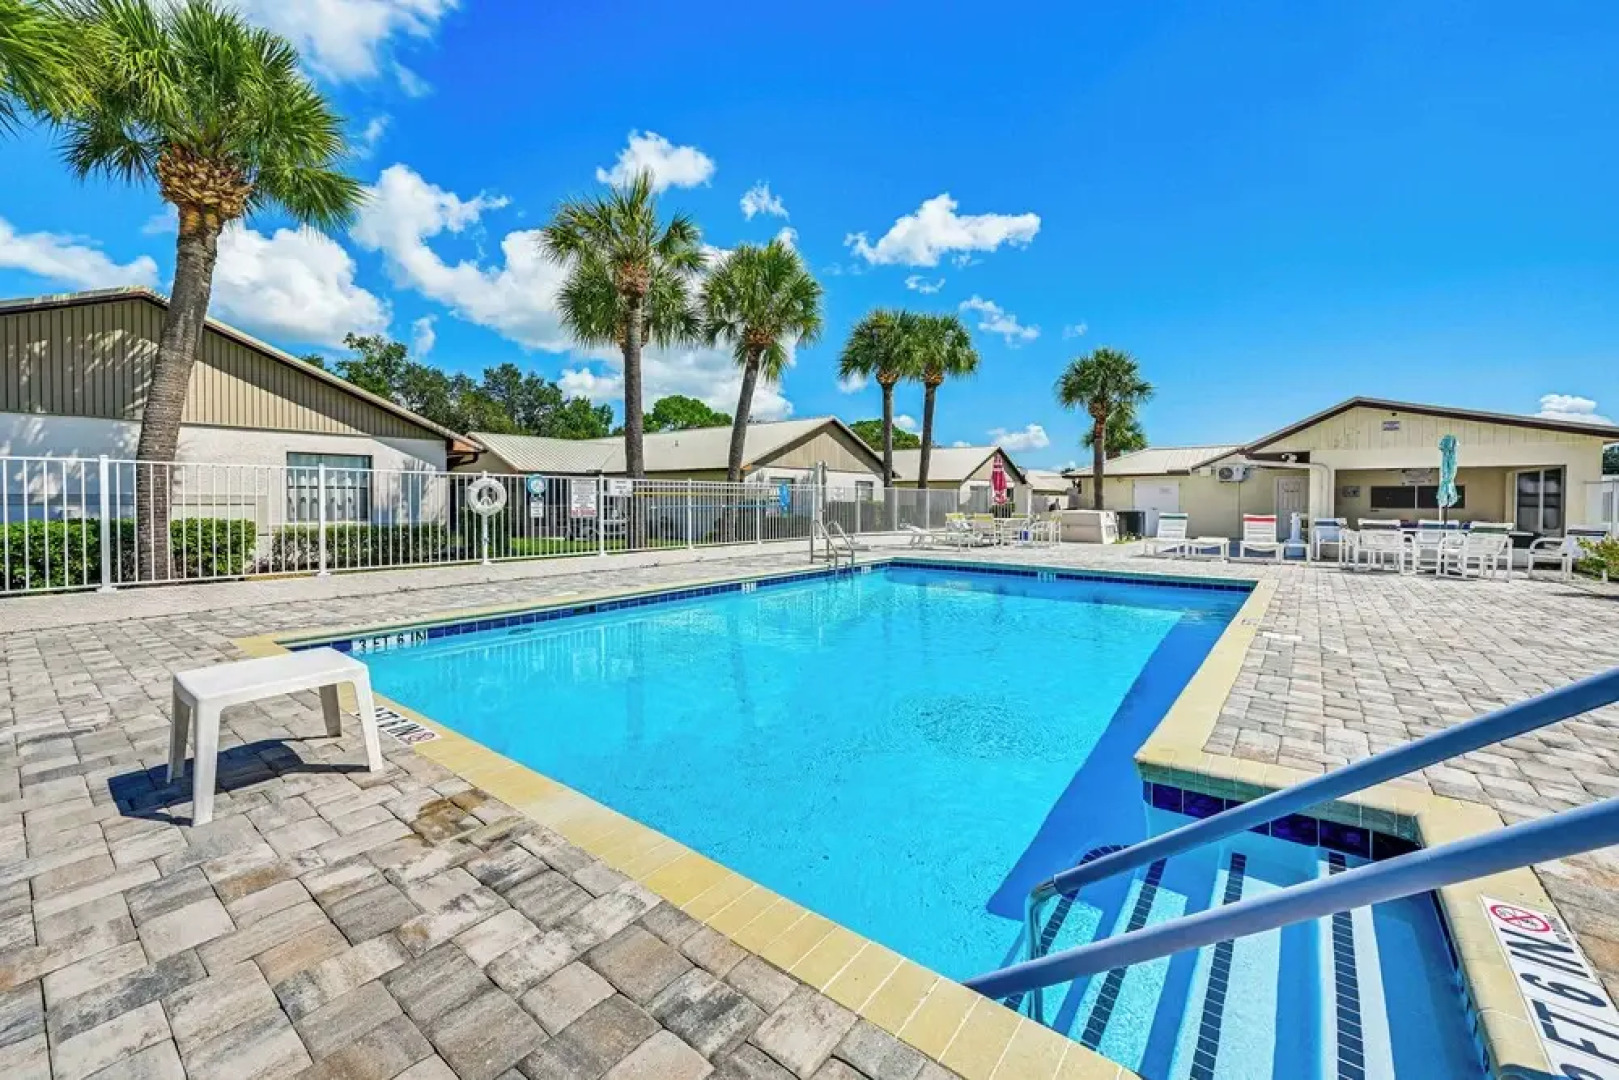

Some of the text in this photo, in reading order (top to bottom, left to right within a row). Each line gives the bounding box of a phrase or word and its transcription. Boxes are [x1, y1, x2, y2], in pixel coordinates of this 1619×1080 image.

[374, 634, 390, 648] FT
[411, 629, 426, 642] IN
[1500, 927, 1591, 979] IN
[1519, 972, 1608, 1008] 6
[1530, 998, 1619, 1065] FT
